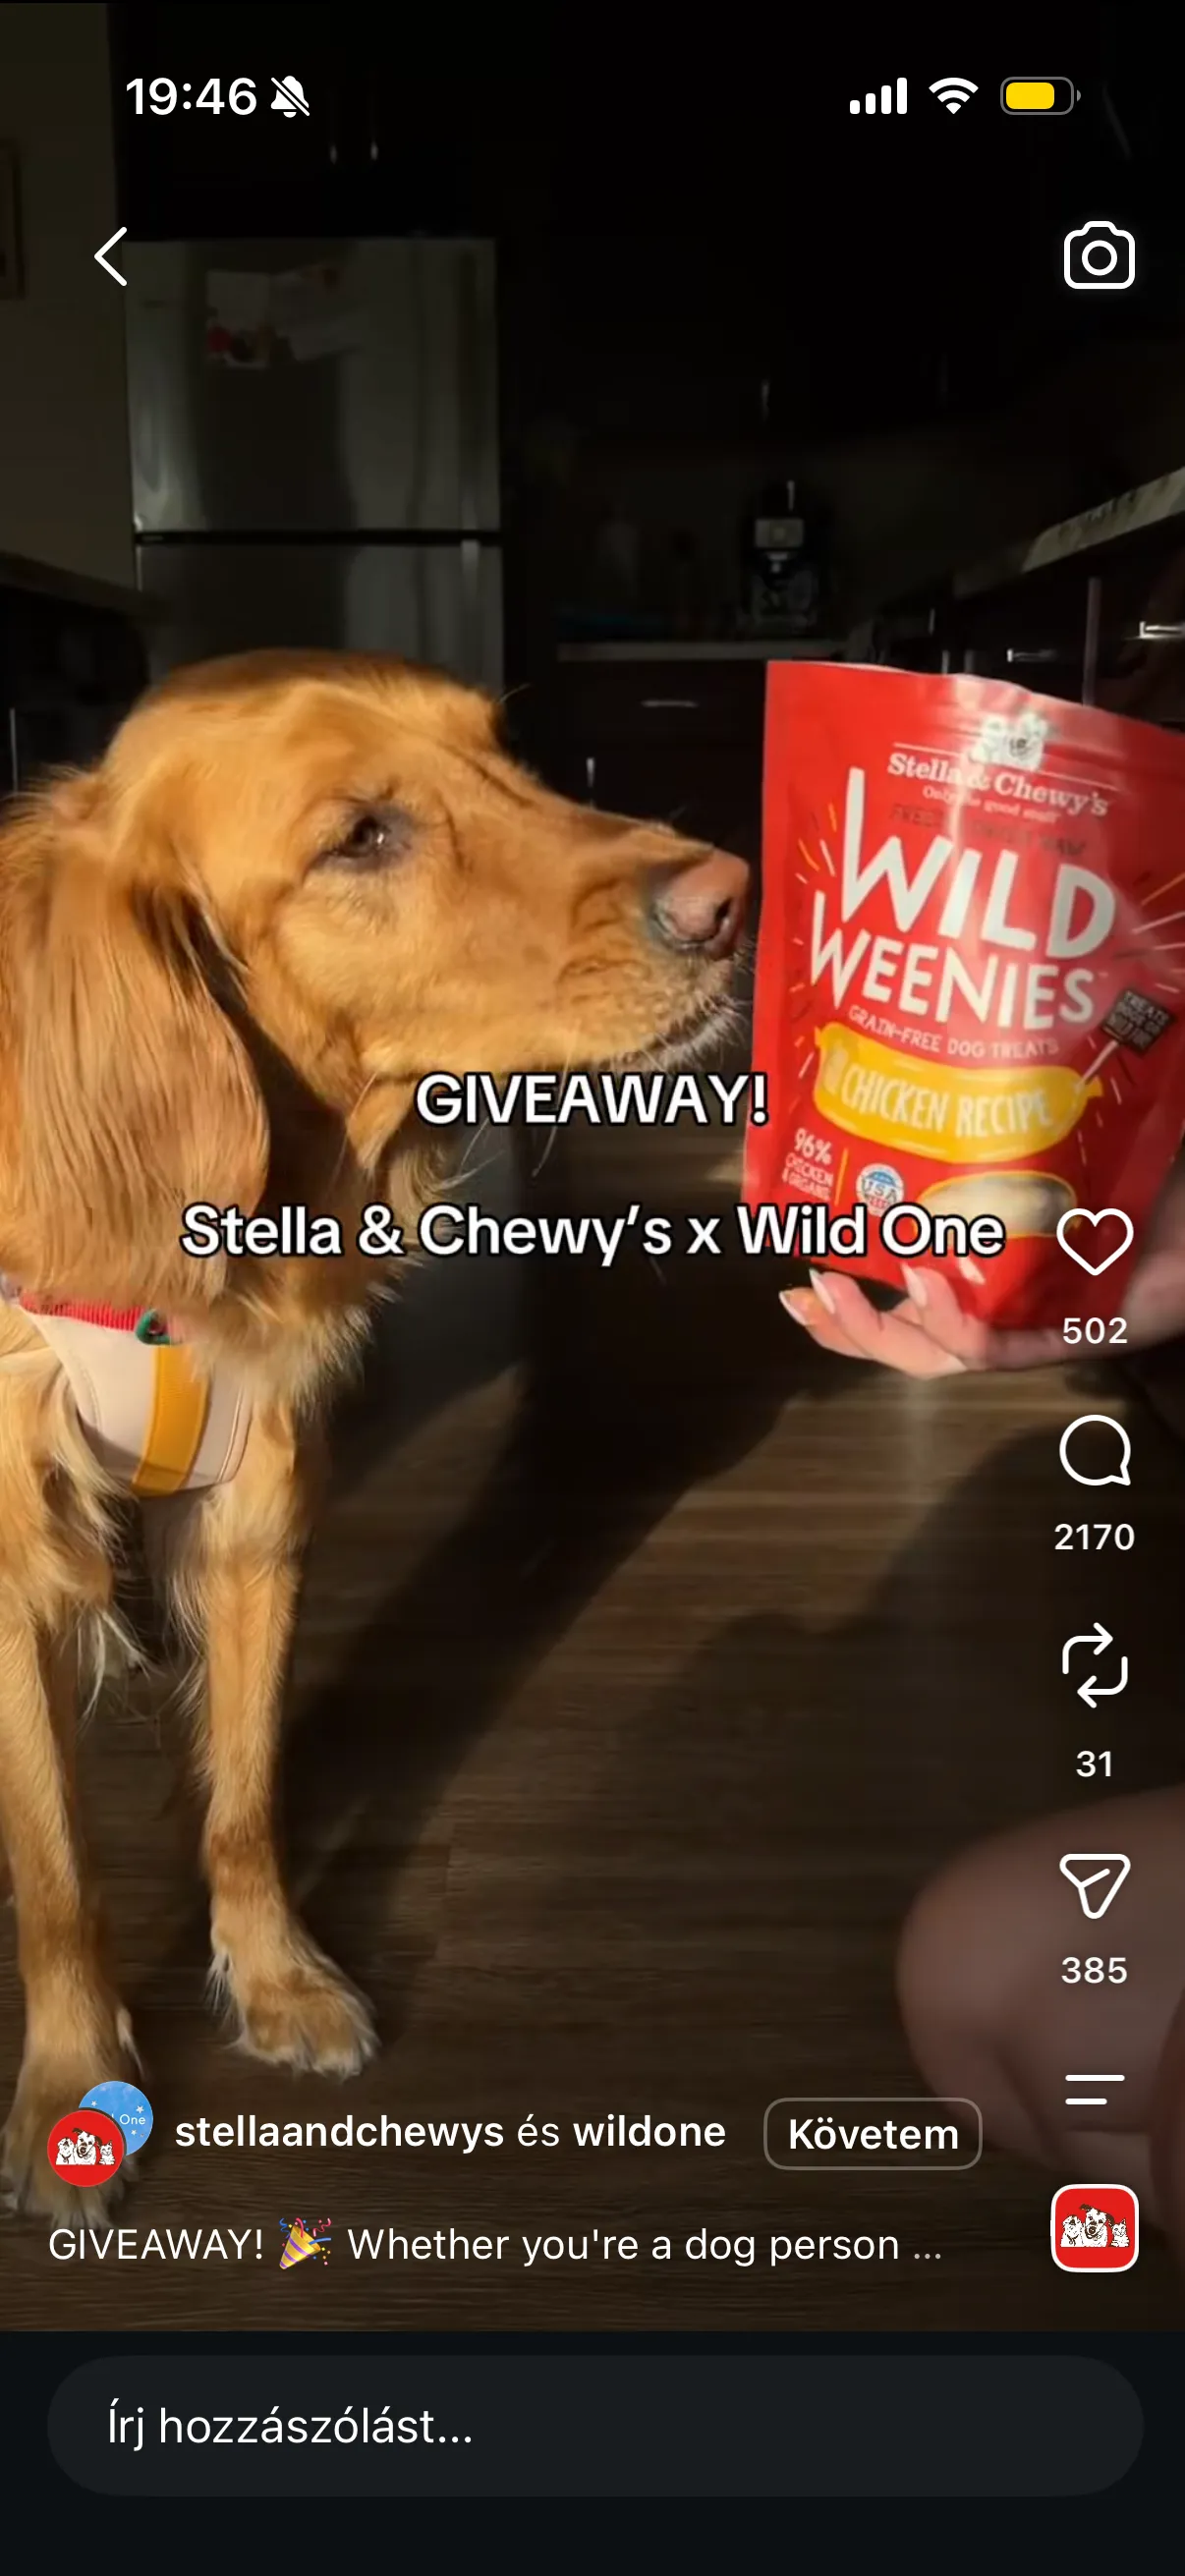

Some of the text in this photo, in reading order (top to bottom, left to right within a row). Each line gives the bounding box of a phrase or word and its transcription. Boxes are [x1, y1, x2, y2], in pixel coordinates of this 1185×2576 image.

[887, 752, 964, 786] Stella
[994, 770, 1109, 816] Chewy's
[842, 765, 1116, 960] WILD
[811, 889, 1096, 1031] WEENIES
[848, 1005, 1060, 1060] GRAIN-FREE DOG TREATS
[841, 1064, 1052, 1139] CHICKEN RECIPE
[794, 1127, 833, 1165] 96%
[861, 1177, 898, 1204] USA
